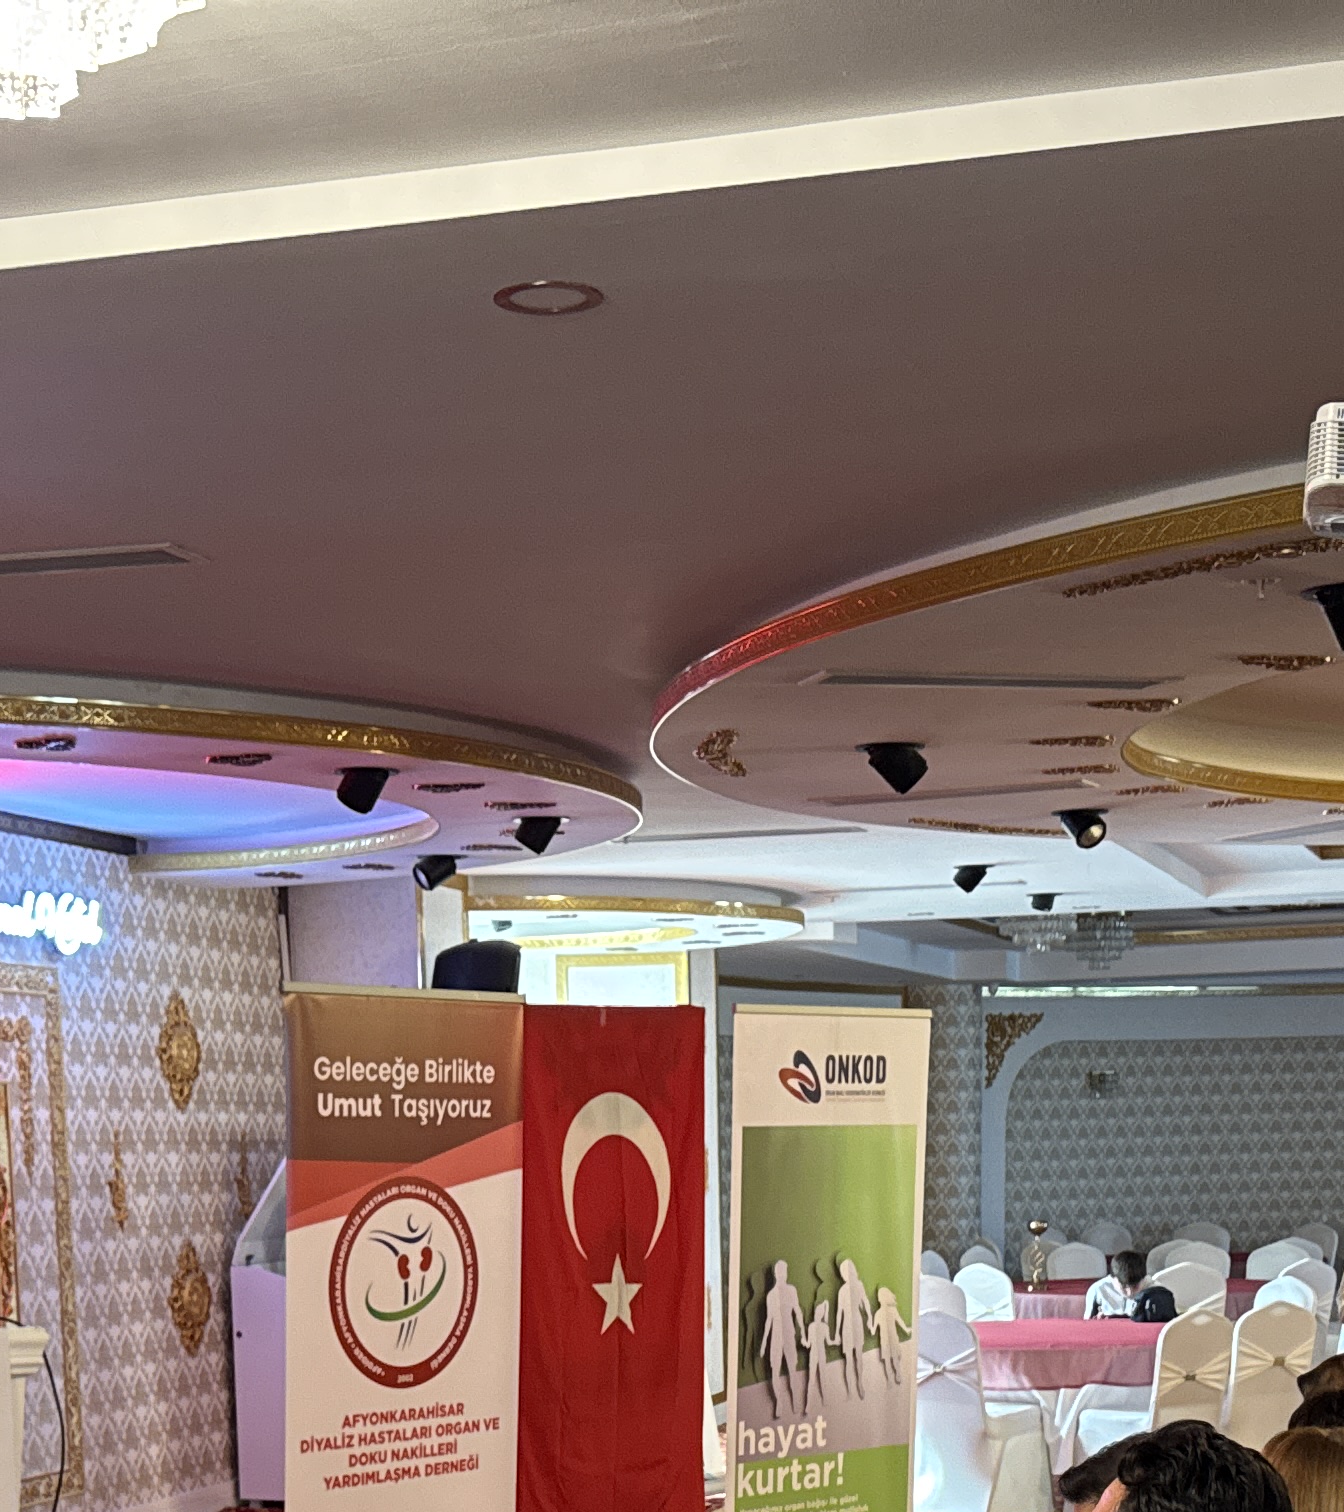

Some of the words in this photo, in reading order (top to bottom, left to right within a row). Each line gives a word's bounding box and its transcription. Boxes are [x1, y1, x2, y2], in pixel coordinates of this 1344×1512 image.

[313, 1056, 420, 1090] Geleceğe
[425, 1057, 496, 1084] Birlikte
[825, 1054, 886, 1084] ONKOD
[317, 1093, 382, 1118] Umut
[391, 1094, 492, 1126] Taşıyoruz
[341, 1401, 465, 1429] AFYONKARAHİSAR
[300, 1432, 355, 1454] DİYALİZ
[358, 1425, 432, 1447] HASTALARI
[435, 1419, 481, 1437] ORGAN
[483, 1417, 500, 1430] VE
[348, 1450, 388, 1468] DOKU
[390, 1437, 458, 1462] NAKİLLERİ
[738, 1415, 827, 1458] hayat
[323, 1465, 421, 1491] YARDIMLAŞMA
[424, 1454, 479, 1477] DERNEĞİ
[737, 1452, 844, 1498] kurtar!
